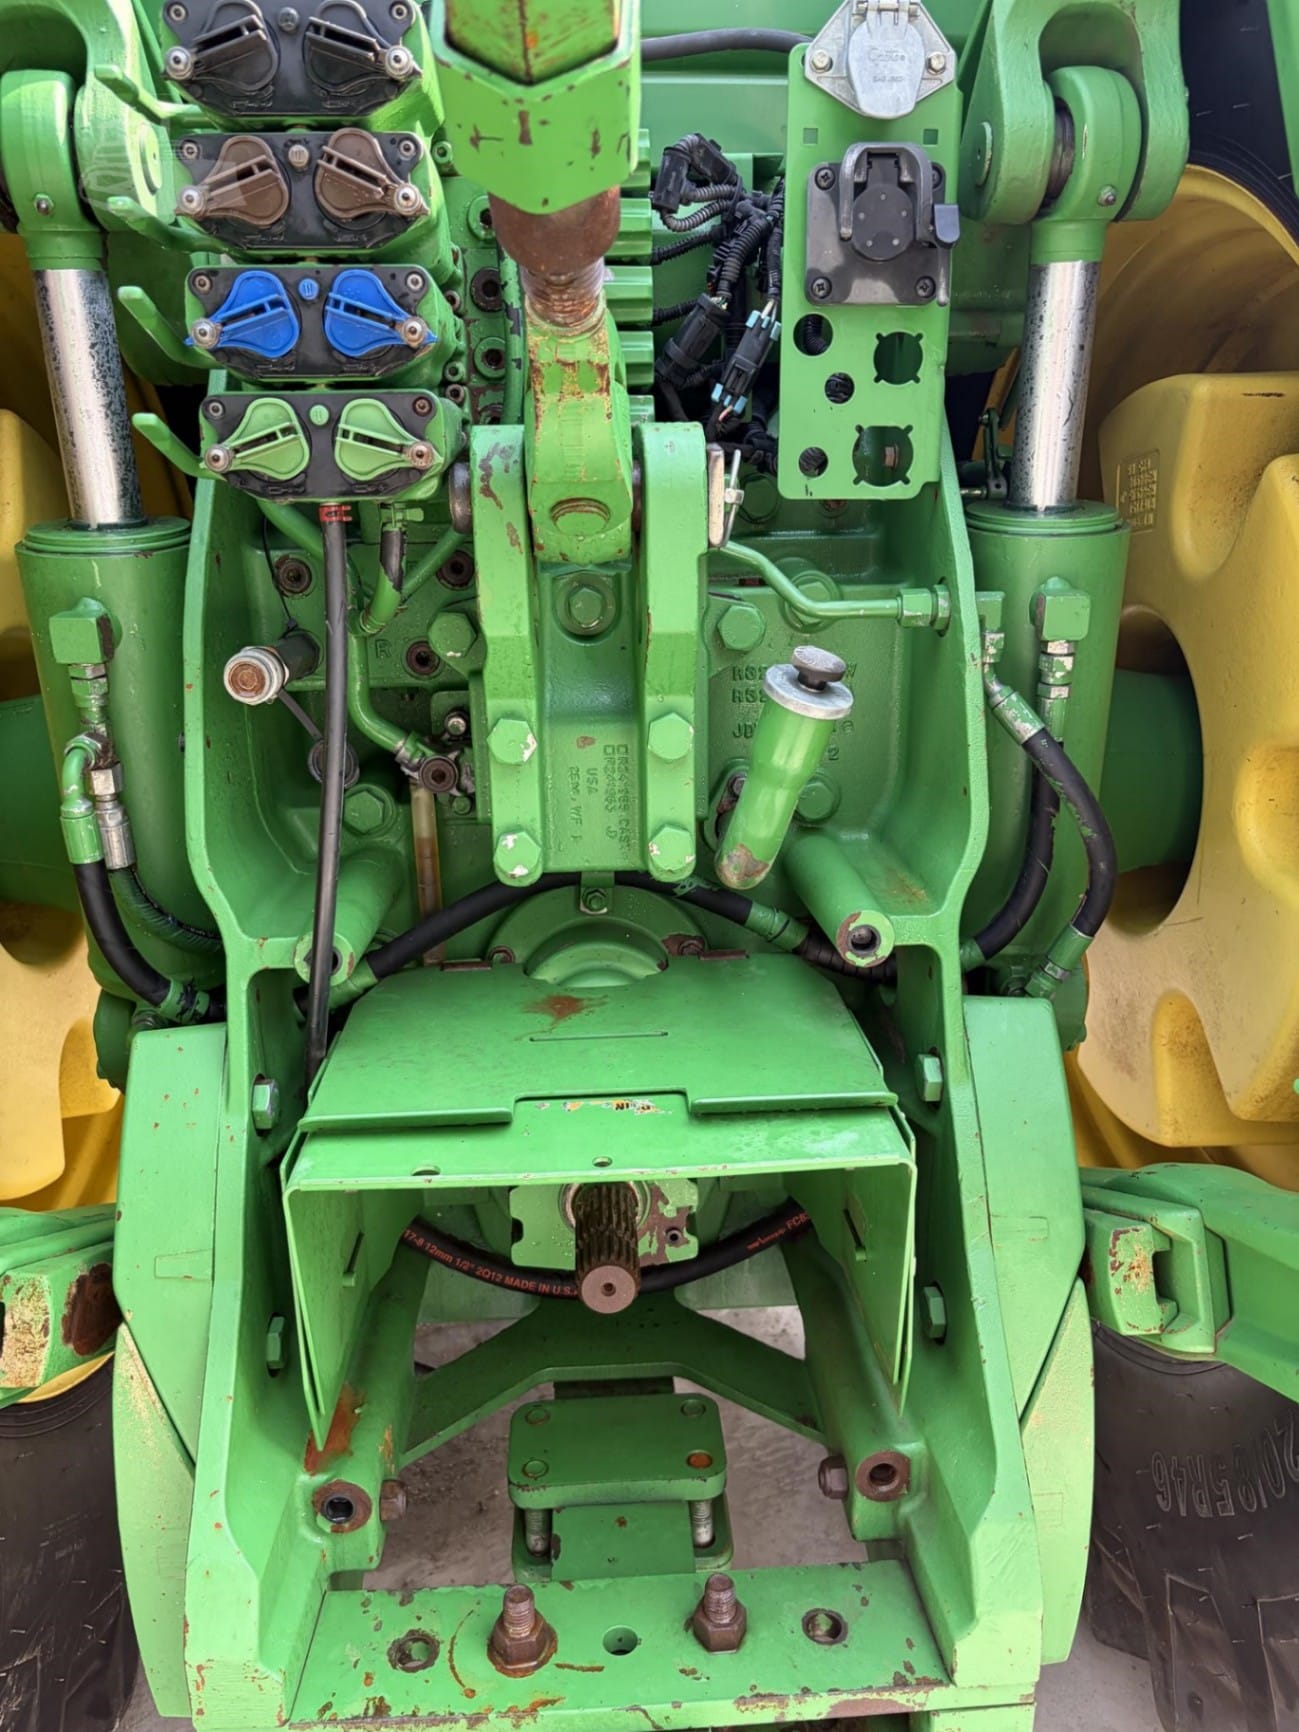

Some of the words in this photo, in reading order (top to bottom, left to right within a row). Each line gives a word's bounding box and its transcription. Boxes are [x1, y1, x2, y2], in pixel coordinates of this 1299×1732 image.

[375, 638, 393, 658] R
[586, 767, 599, 795] USA
[424, 1242, 454, 1263] 12mm
[504, 1276, 537, 1291] MADE
[538, 1283, 550, 1294] IN
